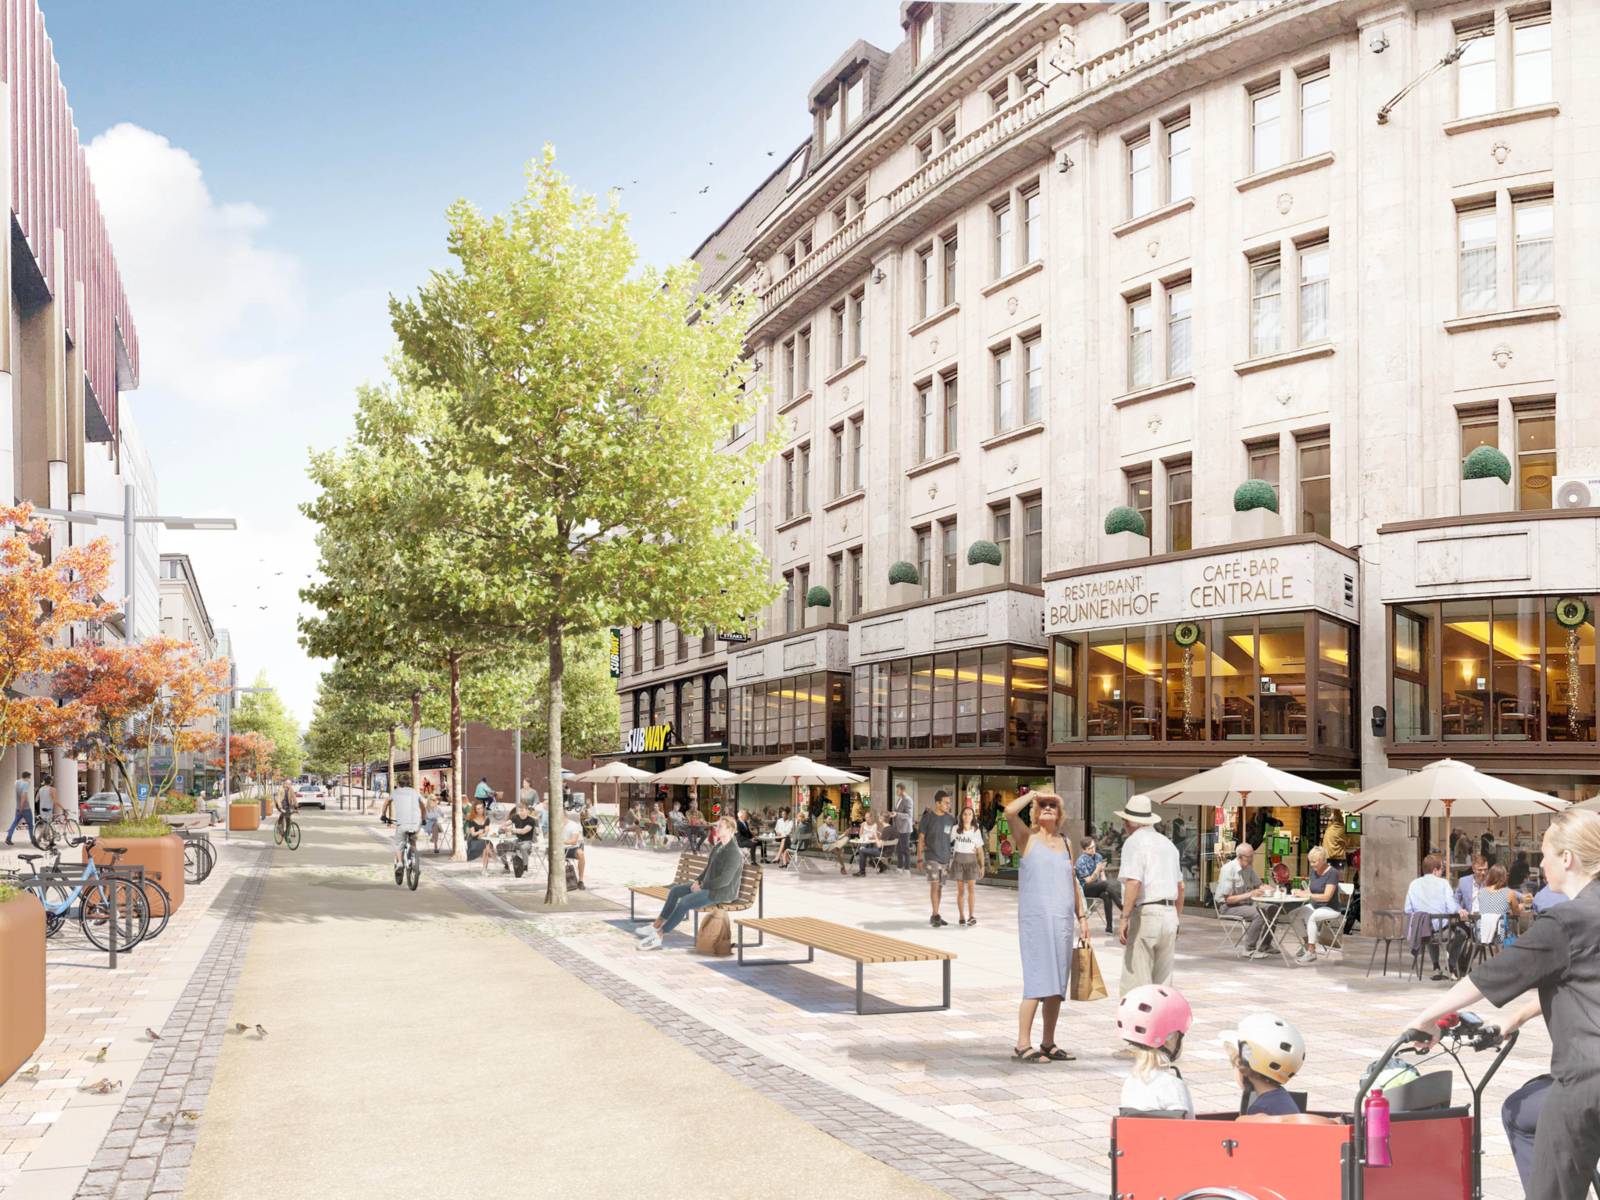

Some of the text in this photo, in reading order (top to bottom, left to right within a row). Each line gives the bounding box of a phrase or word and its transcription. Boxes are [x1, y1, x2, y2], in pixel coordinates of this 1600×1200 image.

[1249, 557, 1279, 577] BAR
[1065, 576, 1142, 600] RESTAURANT
[1190, 576, 1293, 608] CENTRALE
[1050, 592, 1159, 626] BRUNNENHOF
[610, 631, 620, 675] SUBWAY
[625, 723, 671, 753] SUBWAY
